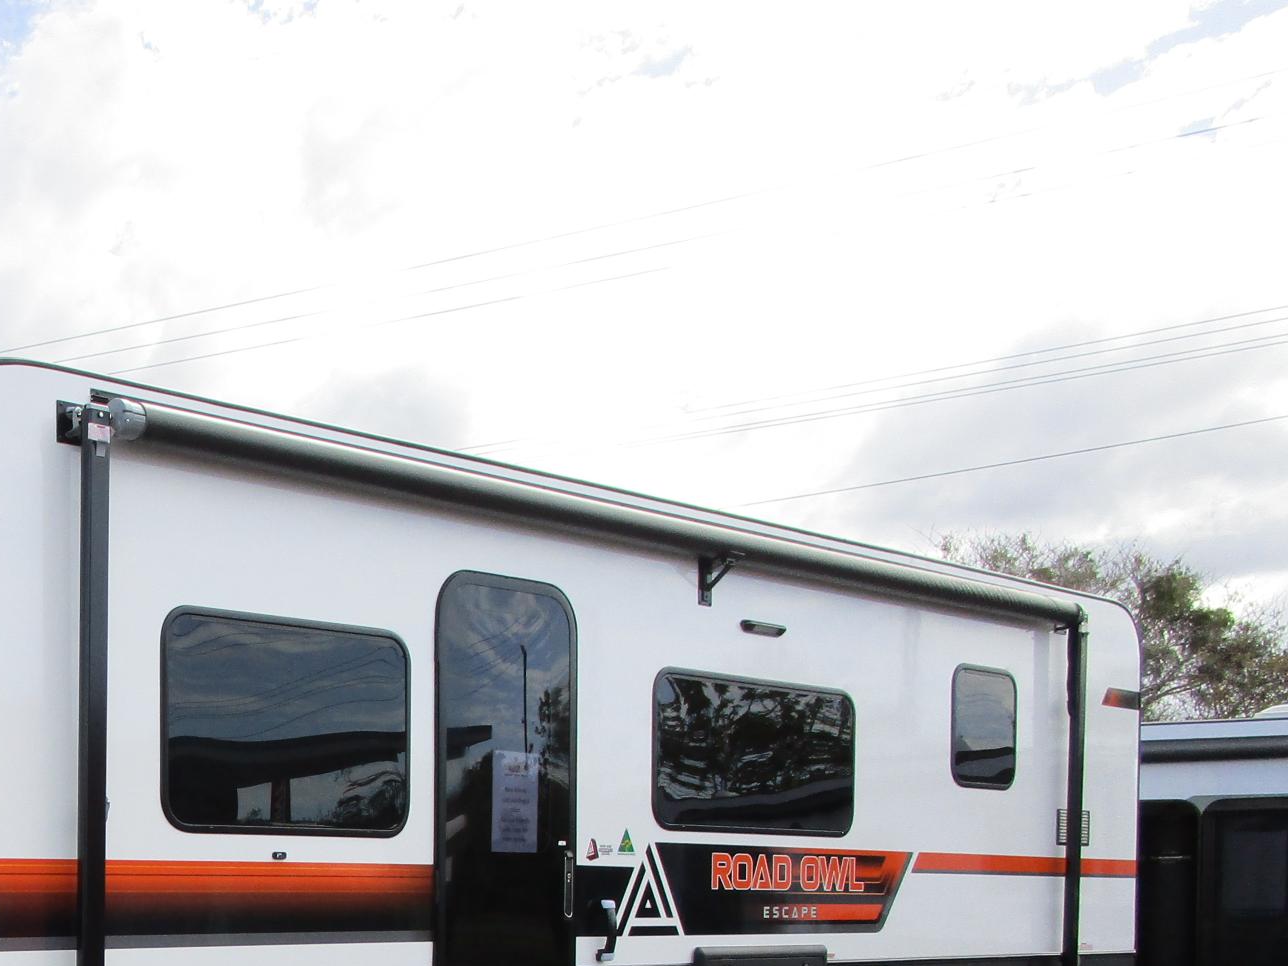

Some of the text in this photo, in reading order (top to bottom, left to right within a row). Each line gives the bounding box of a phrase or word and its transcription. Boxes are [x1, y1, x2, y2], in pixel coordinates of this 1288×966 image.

[711, 852, 865, 892] ROAD OWL
[763, 906, 817, 919] ESCAPE
